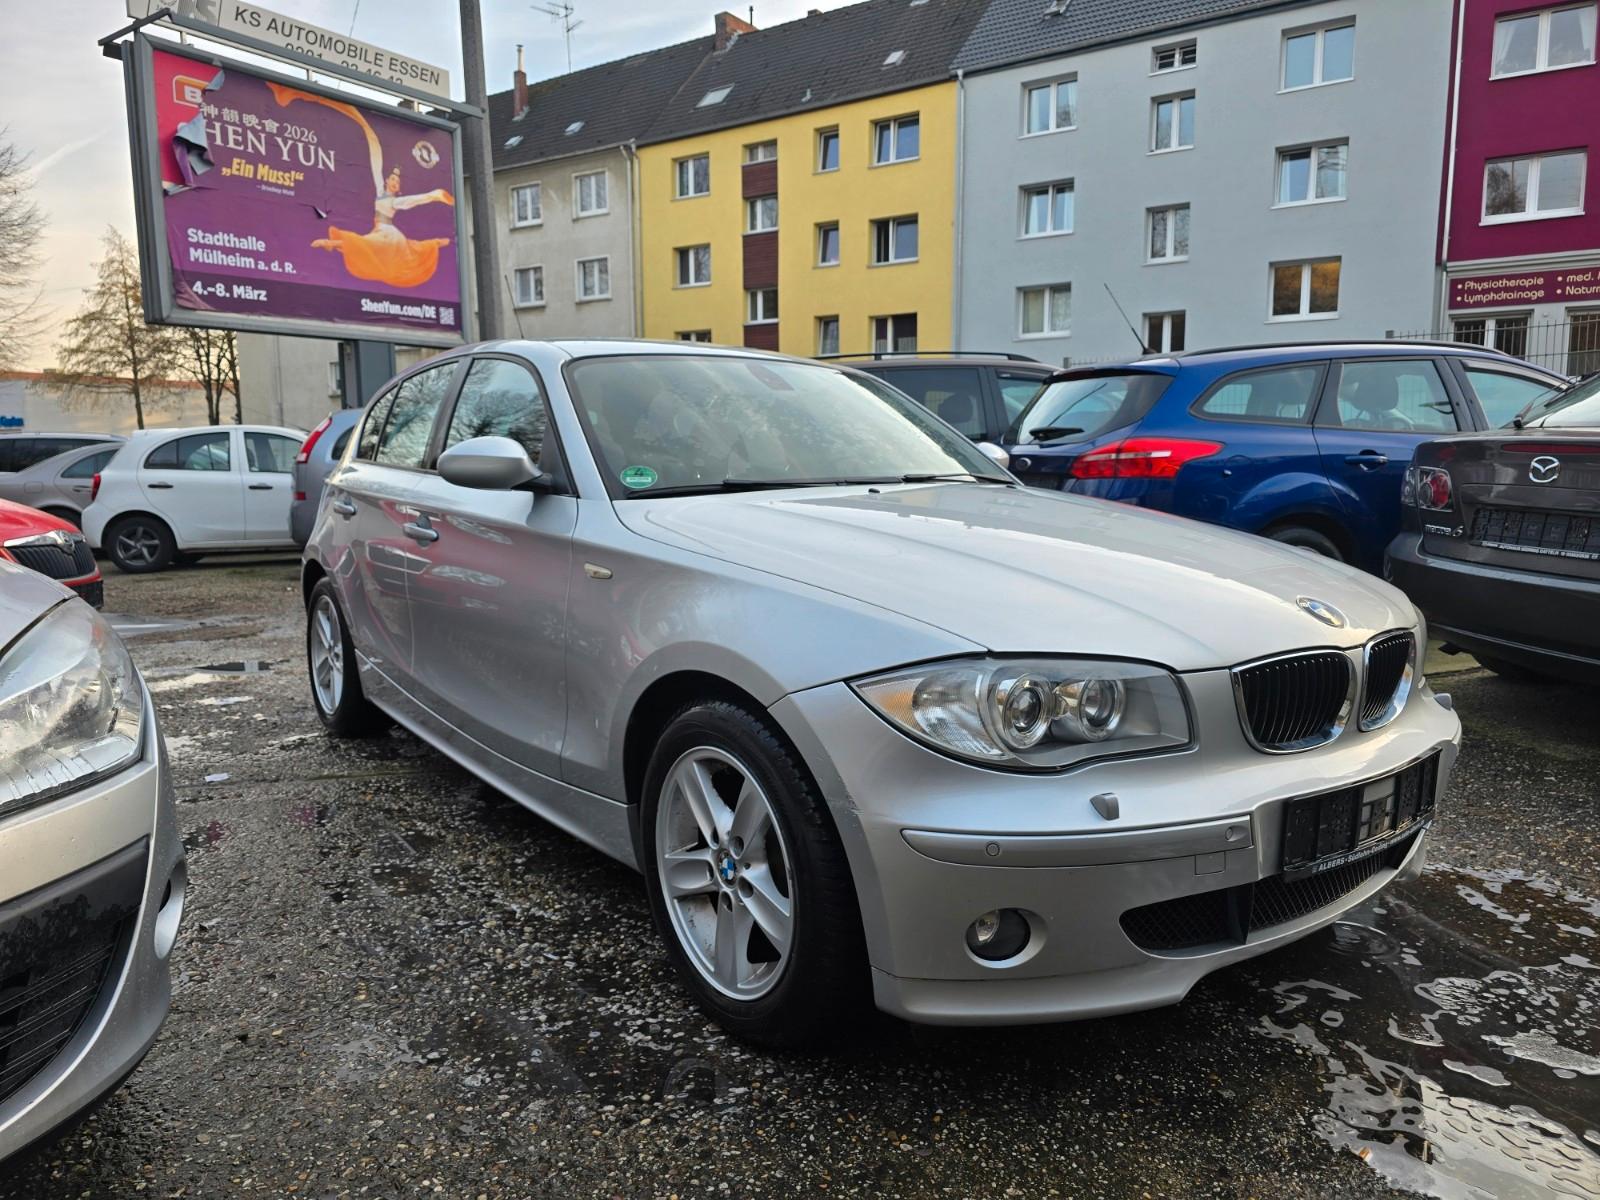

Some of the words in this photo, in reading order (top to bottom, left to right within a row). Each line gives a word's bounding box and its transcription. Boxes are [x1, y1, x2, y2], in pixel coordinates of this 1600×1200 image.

[235, 6, 261, 28] KS
[266, 18, 384, 67] AUTOMOBILE
[389, 57, 440, 86] ESSEN
[283, 123, 318, 144] 2026
[275, 136, 336, 173] YUN
[187, 227, 266, 252] Stadthalle
[189, 247, 255, 269] Mülheim
[257, 260, 269, 271] a.
[270, 260, 283, 272] d.
[284, 262, 297, 274] R.
[1464, 277, 1544, 291] Physiotherapie
[1566, 271, 1594, 282] med.
[232, 284, 268, 301] März
[1463, 289, 1545, 304] Lymphdrainage
[360, 298, 437, 319] ShenYun.com/DE
